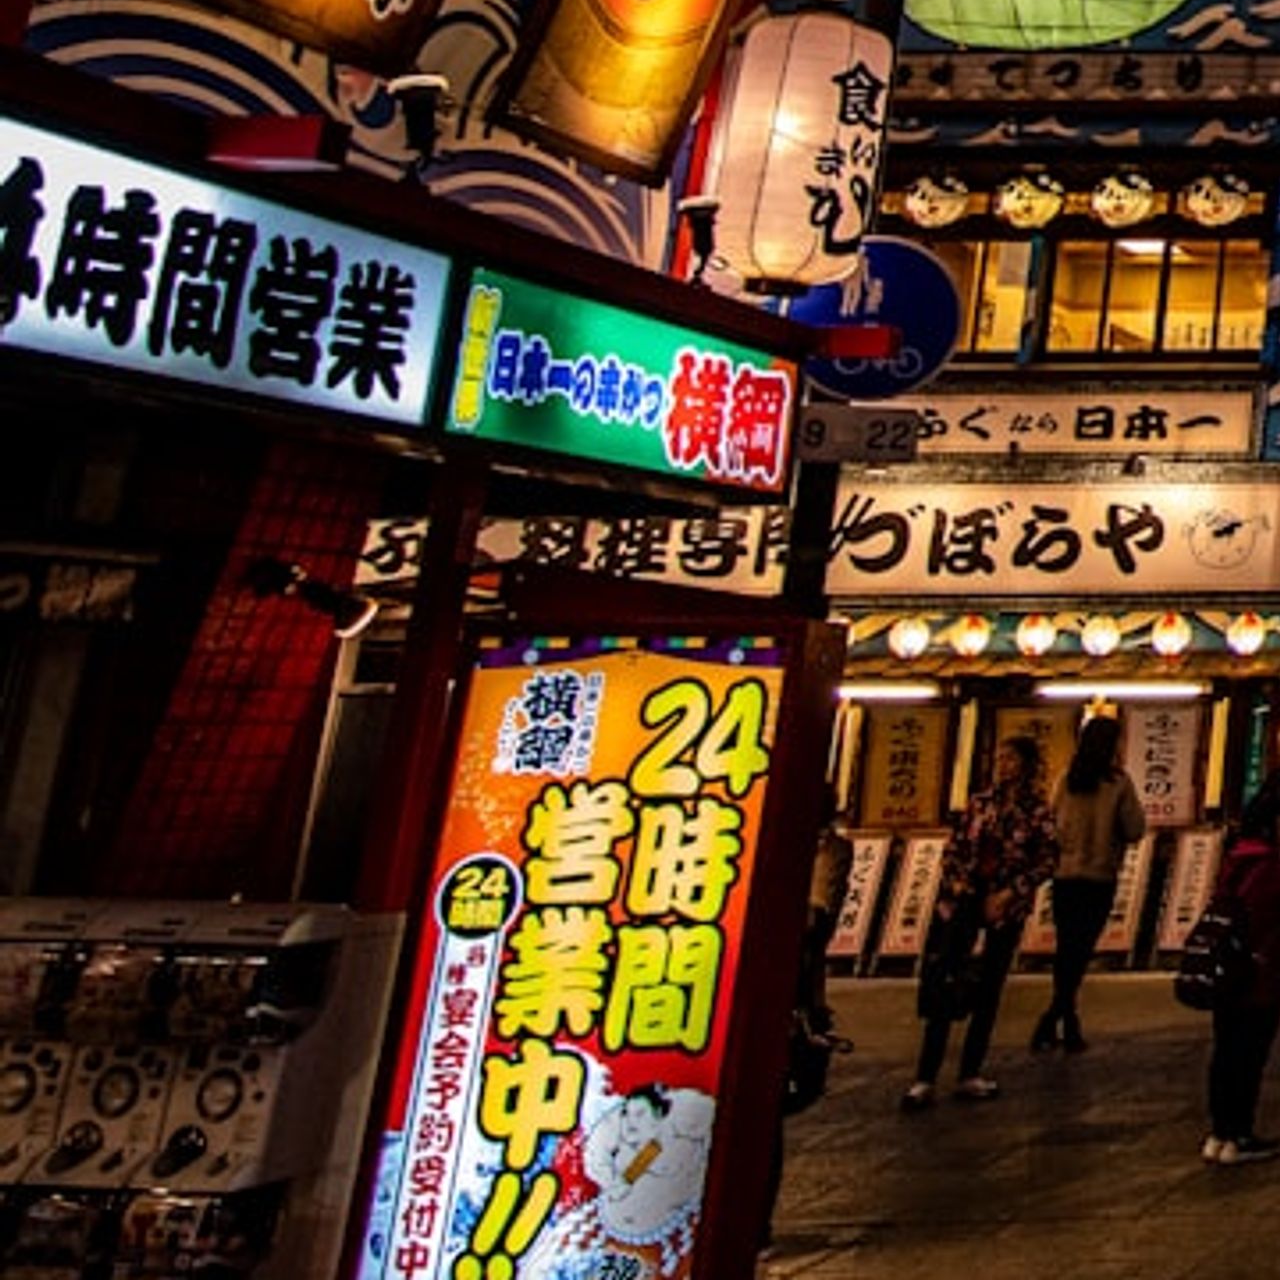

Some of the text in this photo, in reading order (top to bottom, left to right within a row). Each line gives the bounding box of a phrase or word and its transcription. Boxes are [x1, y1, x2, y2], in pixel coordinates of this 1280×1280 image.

[490, 328, 664, 427] 日本一の串かつ
[664, 346, 789, 483] 横綱
[867, 419, 910, 446] 22
[832, 498, 1166, 577] づぼらや
[513, 675, 580, 770] 横綱
[451, 868, 509, 898] 24
[604, 677, 769, 1051] 24時間
